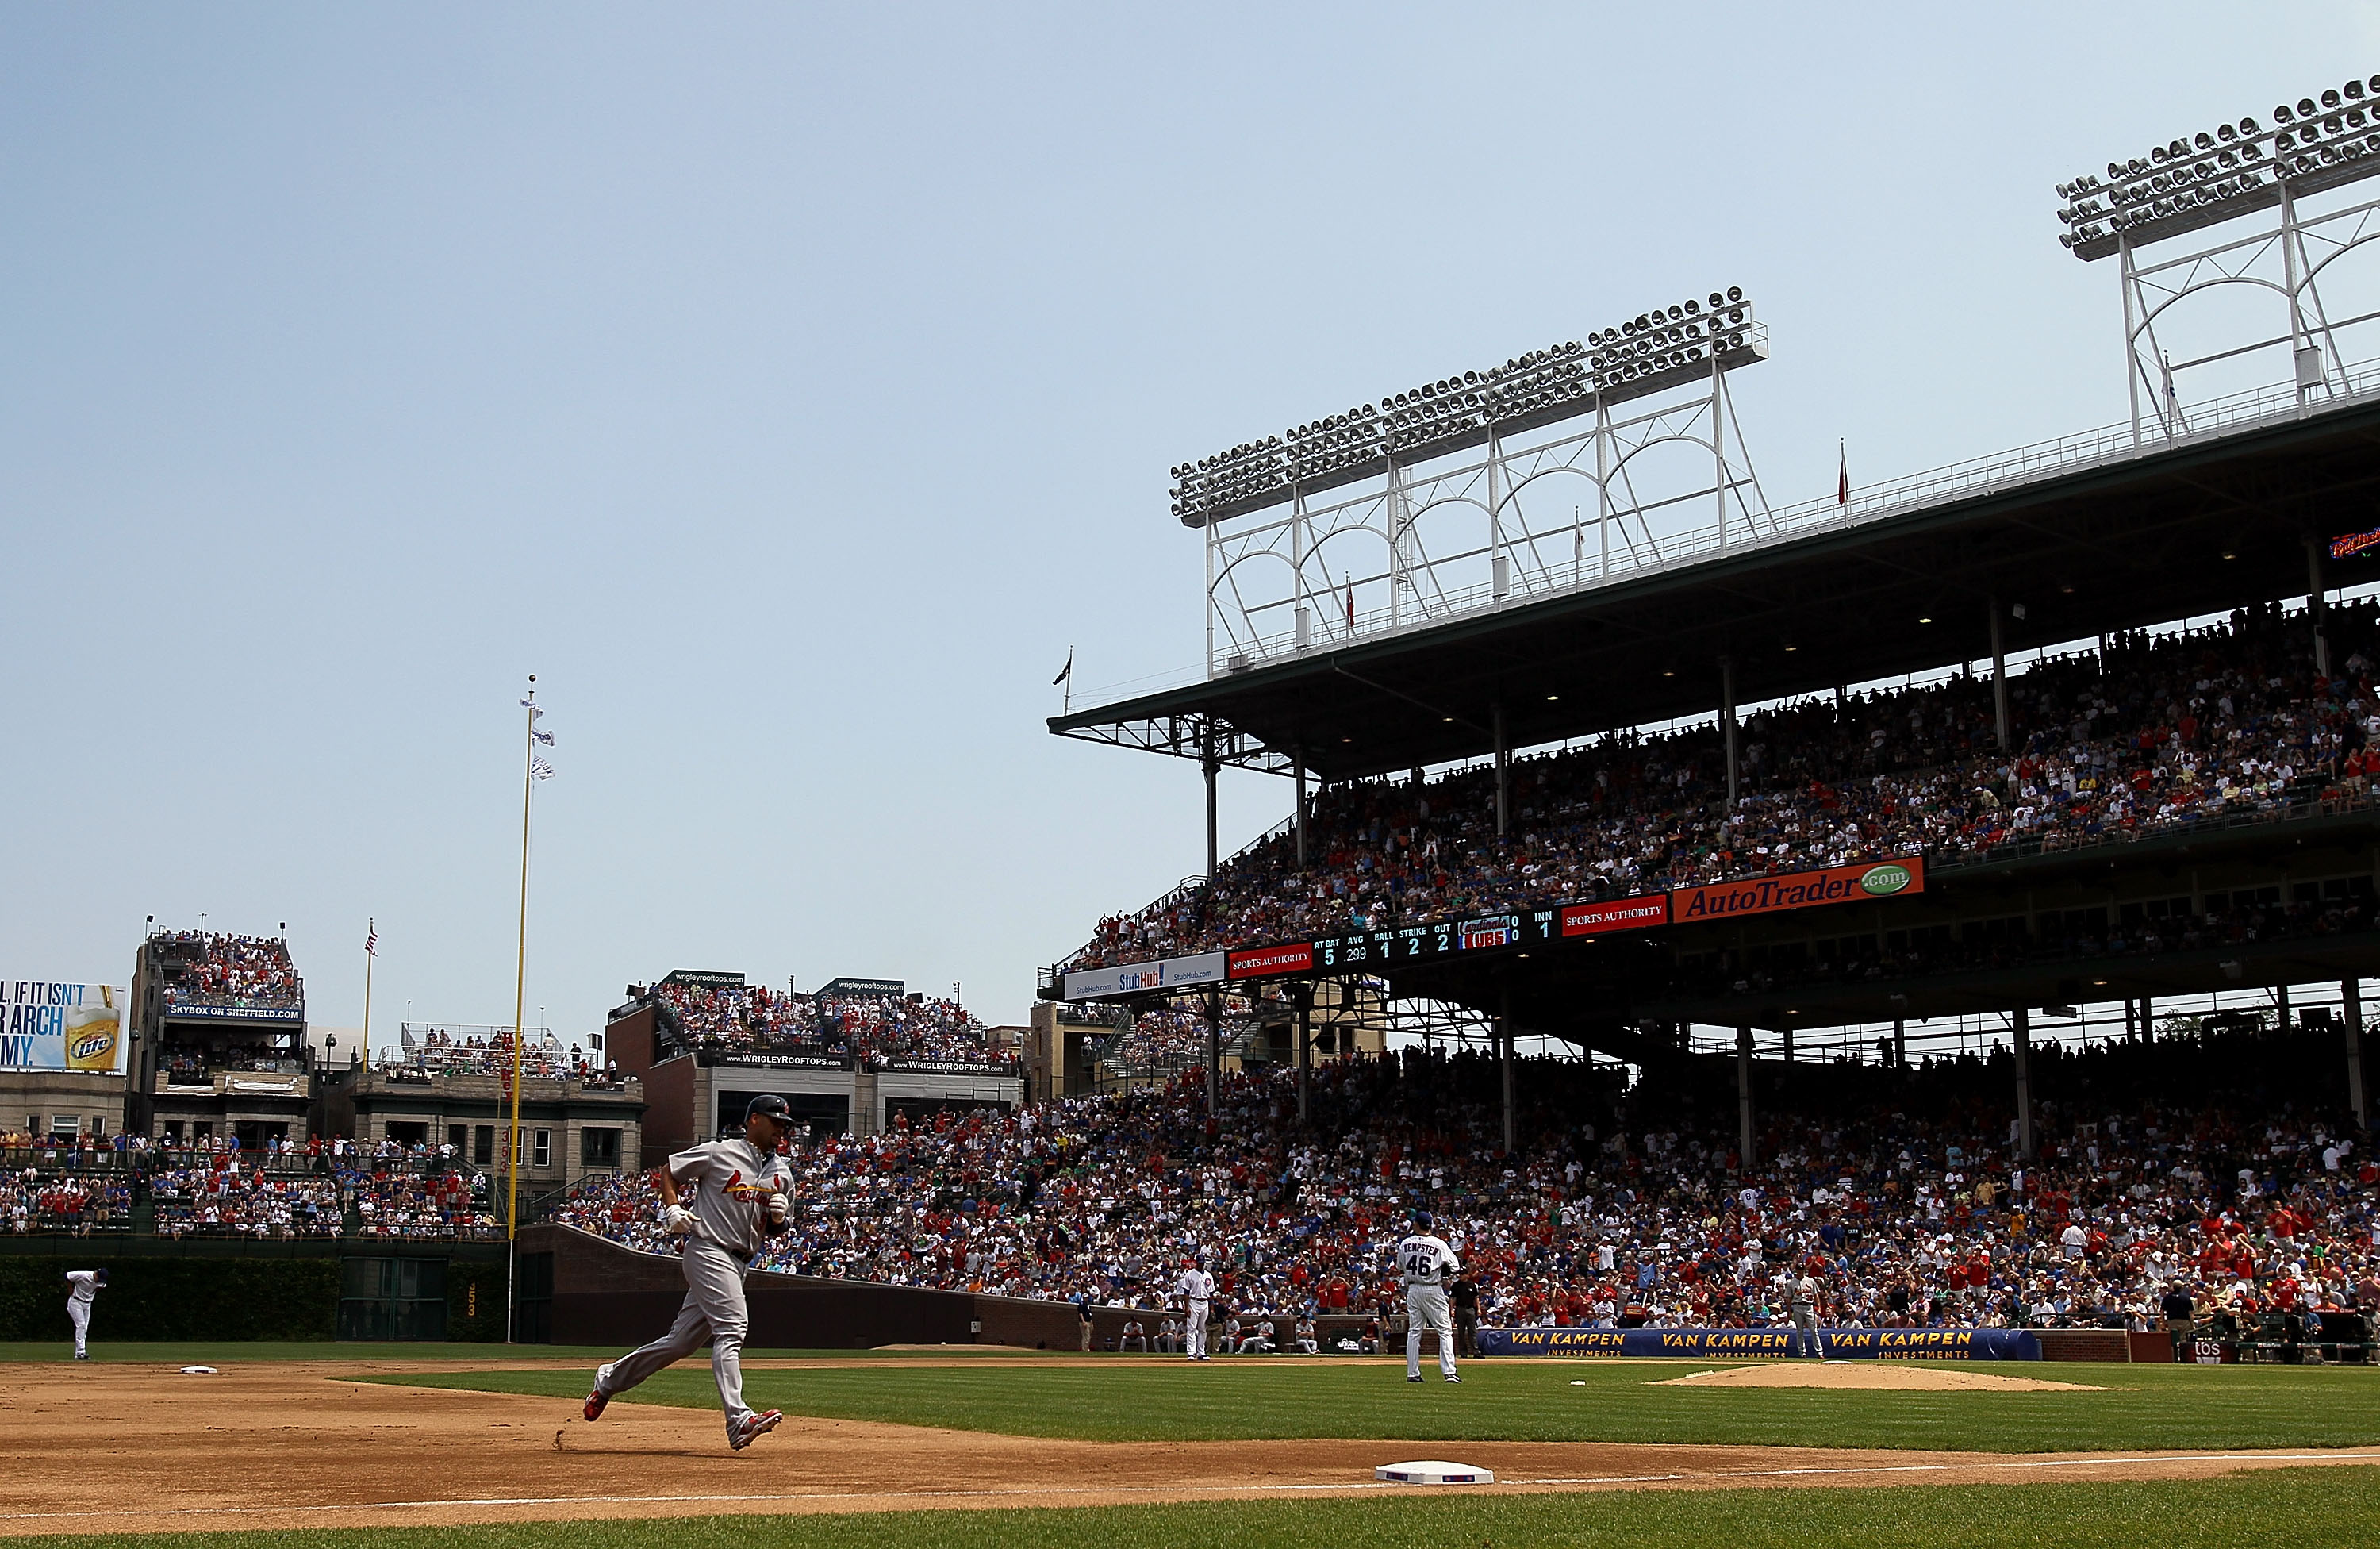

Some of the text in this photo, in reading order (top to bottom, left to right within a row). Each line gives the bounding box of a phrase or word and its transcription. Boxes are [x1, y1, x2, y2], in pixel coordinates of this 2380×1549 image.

[1686, 875, 1860, 917] AutoTrader
[1511, 916, 1519, 927] 0
[1534, 911, 1553, 922] INN
[1566, 905, 1662, 926] SPORTS AUTHORITY
[1399, 927, 1426, 938] STRIKE
[1434, 924, 1451, 933] OUT
[1512, 929, 1519, 940] 0
[1540, 921, 1548, 937] 1
[1325, 939, 1340, 947] BAT
[1347, 935, 1364, 945] AVG
[1374, 932, 1394, 941] BALL
[1438, 934, 1449, 951] 2
[1380, 942, 1388, 958] 1
[1408, 938, 1419, 955] 2
[1233, 952, 1308, 970] SPORTS AUTHORITY
[1325, 949, 1334, 965] 5
[1343, 947, 1367, 962] .299
[676, 973, 743, 983] wrigleyrooftops.com
[1119, 963, 1165, 991] StubHub!
[1173, 971, 1211, 982] StubHub.com
[839, 982, 904, 991] wrigleyrooftops.com
[1077, 983, 1111, 994] StubHub.com
[15, 982, 28, 1003] IF
[31, 982, 44, 1004] IT
[48, 983, 85, 1006] ISN'T
[171, 1005, 208, 1015] SKYBOX
[226, 1009, 299, 1019] SHEFFIELD.COM
[10, 1005, 63, 1036] ARCH
[1406, 1255, 1431, 1276] 46
[1511, 1332, 1626, 1345] VAN KAMPEN
[1663, 1333, 1789, 1347] VAN KAMPEN
[1830, 1332, 1972, 1347] VAN KAMPEN
[1879, 1351, 1969, 1359] INVESTMENTS
[2195, 1342, 2221, 1355] tbs
